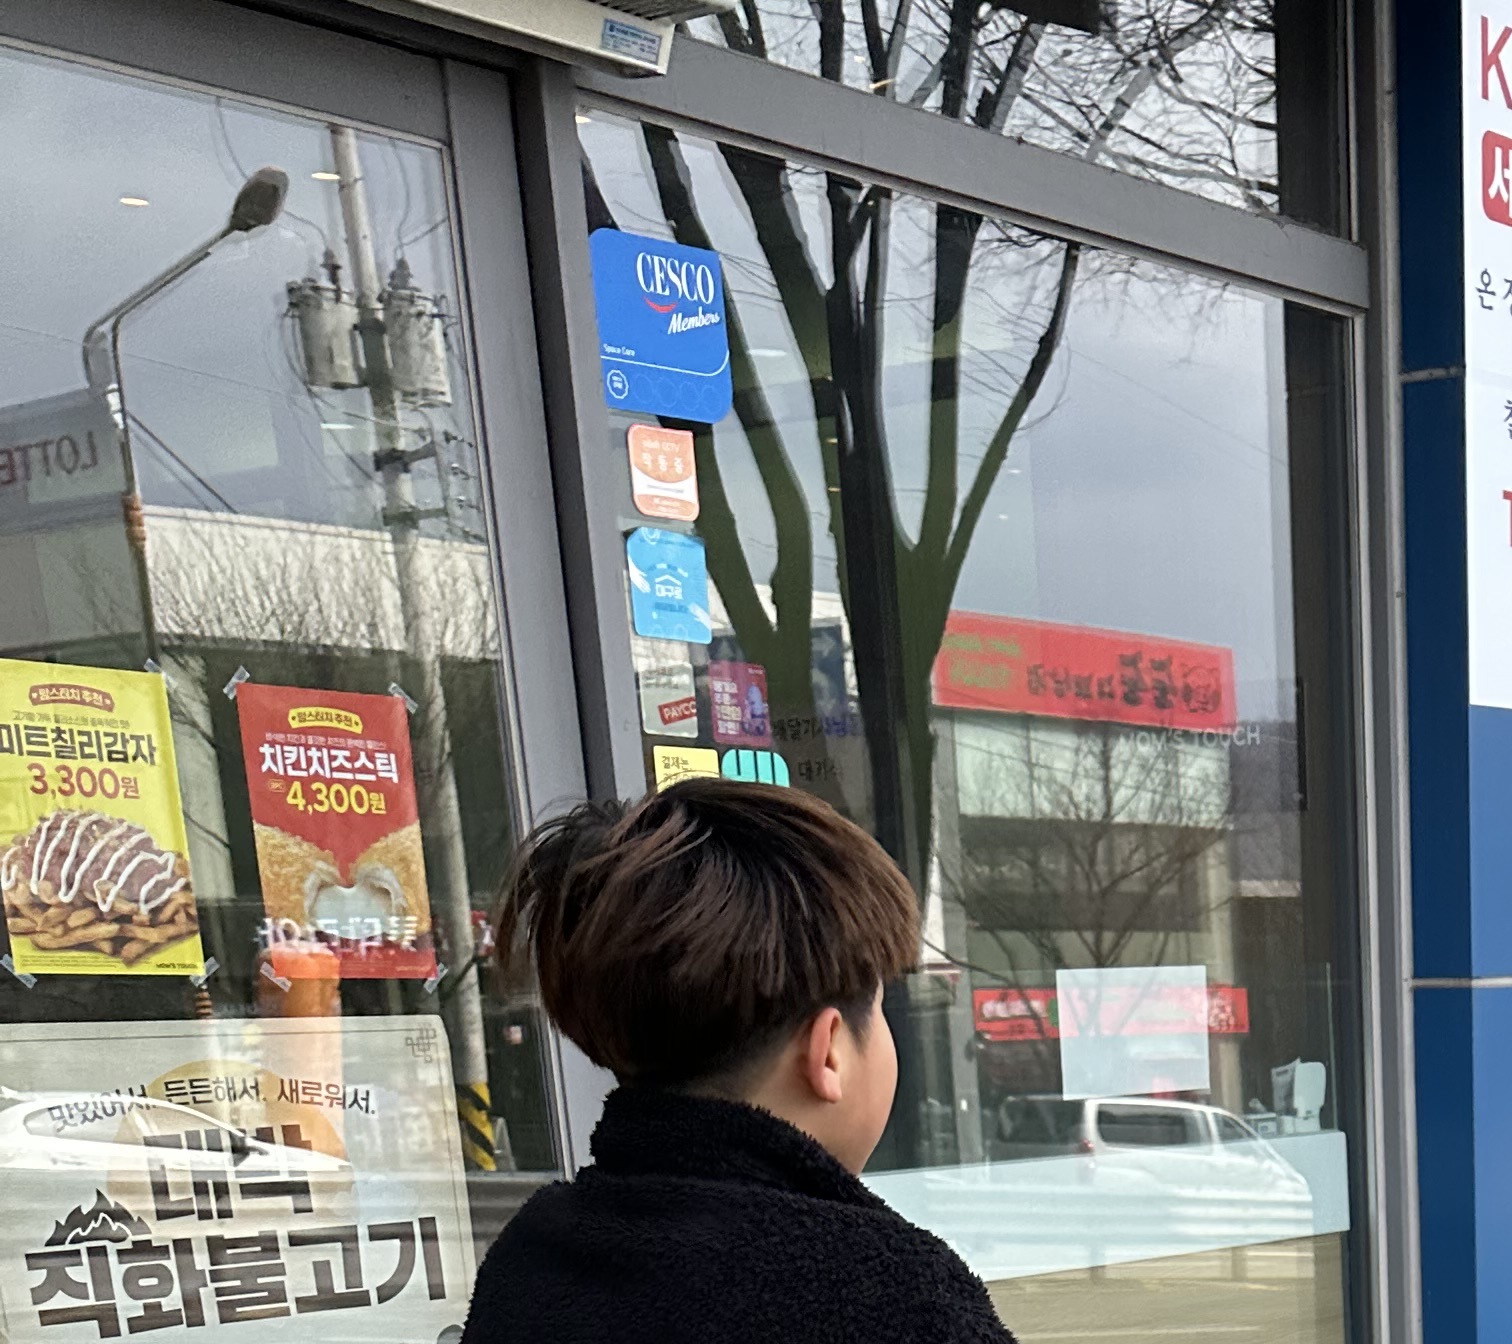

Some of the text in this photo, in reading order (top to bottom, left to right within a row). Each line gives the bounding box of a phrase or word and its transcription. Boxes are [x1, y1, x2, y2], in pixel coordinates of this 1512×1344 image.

[636, 252, 715, 304] CESCO
[1476, 268, 1494, 310] 온
[667, 306, 720, 334] Members
[38, 688, 104, 706] 맘스터치 추천
[297, 710, 353, 728] 맘스터치 추천
[1120, 725, 1260, 751] MOM'S TOUCH
[0, 723, 157, 766] 미트칠리감자
[259, 743, 399, 784] 치킨치즈스틱
[27, 762, 141, 800] 3,300원
[286, 781, 387, 816] 4,300원
[164, 1076, 267, 1106] 든든해서.
[277, 1079, 377, 1116] 새로워서.
[24, 1216, 447, 1339] 직화불고기
